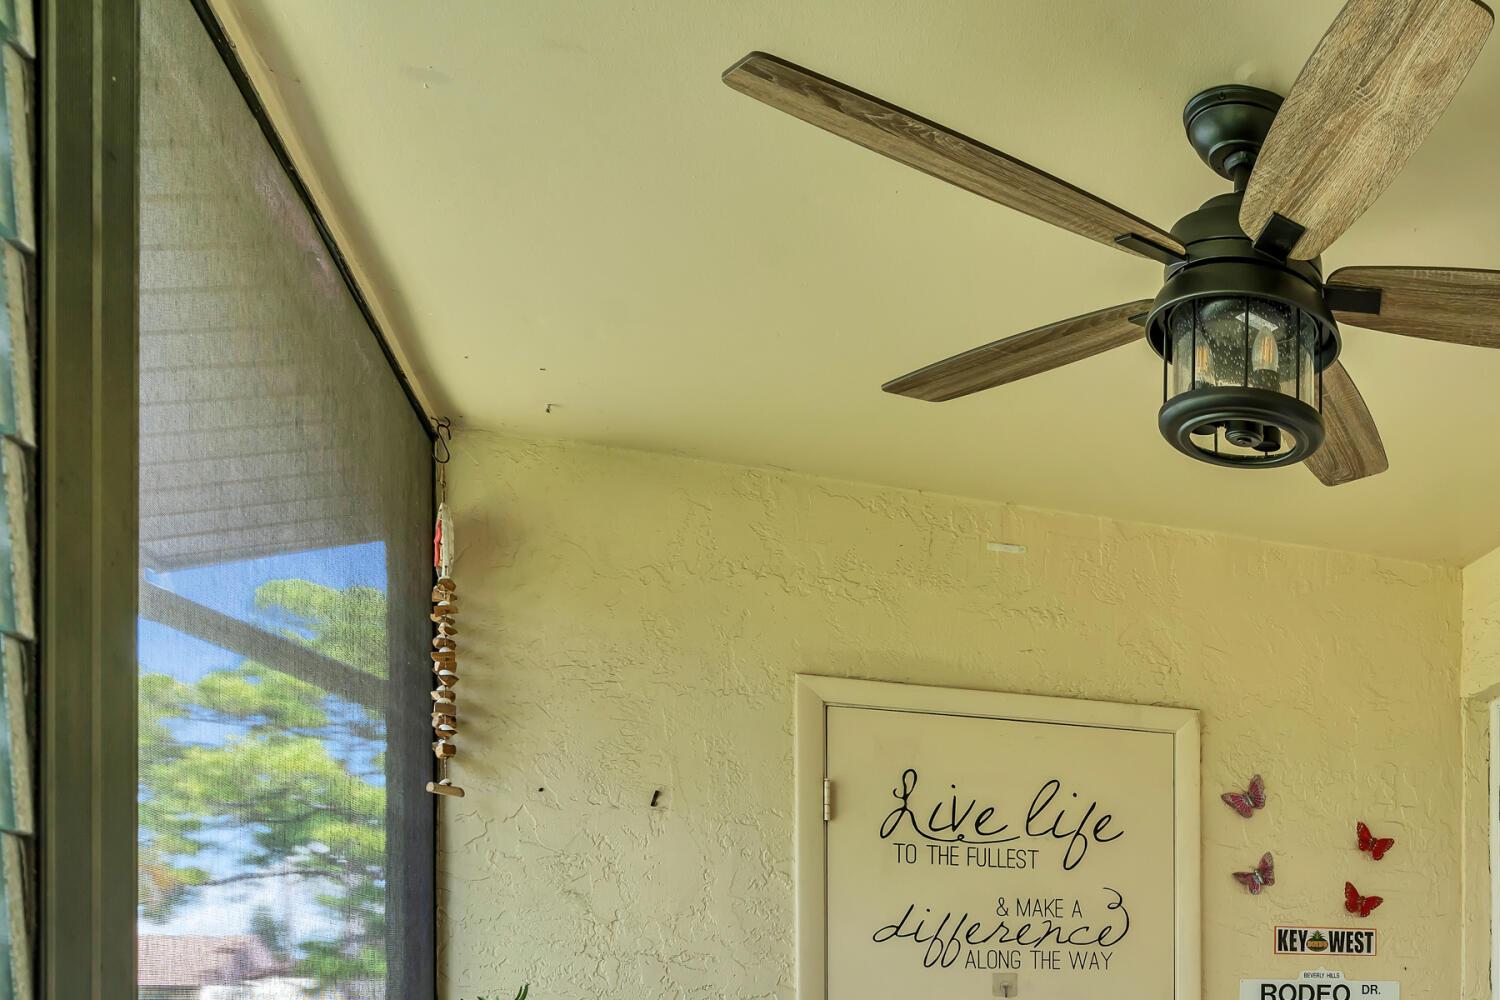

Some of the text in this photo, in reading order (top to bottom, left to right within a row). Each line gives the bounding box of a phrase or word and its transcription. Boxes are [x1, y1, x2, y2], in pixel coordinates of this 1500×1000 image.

[880, 768, 1124, 870] Live life
[893, 843, 1039, 869] TO THE FULLEST
[996, 897, 1083, 918] & MAKE A
[873, 887, 1130, 968] difference
[1277, 929, 1374, 953] KEY WEST
[964, 950, 1113, 970] ALONG THE WAY
[1361, 984, 1381, 995] DR.
